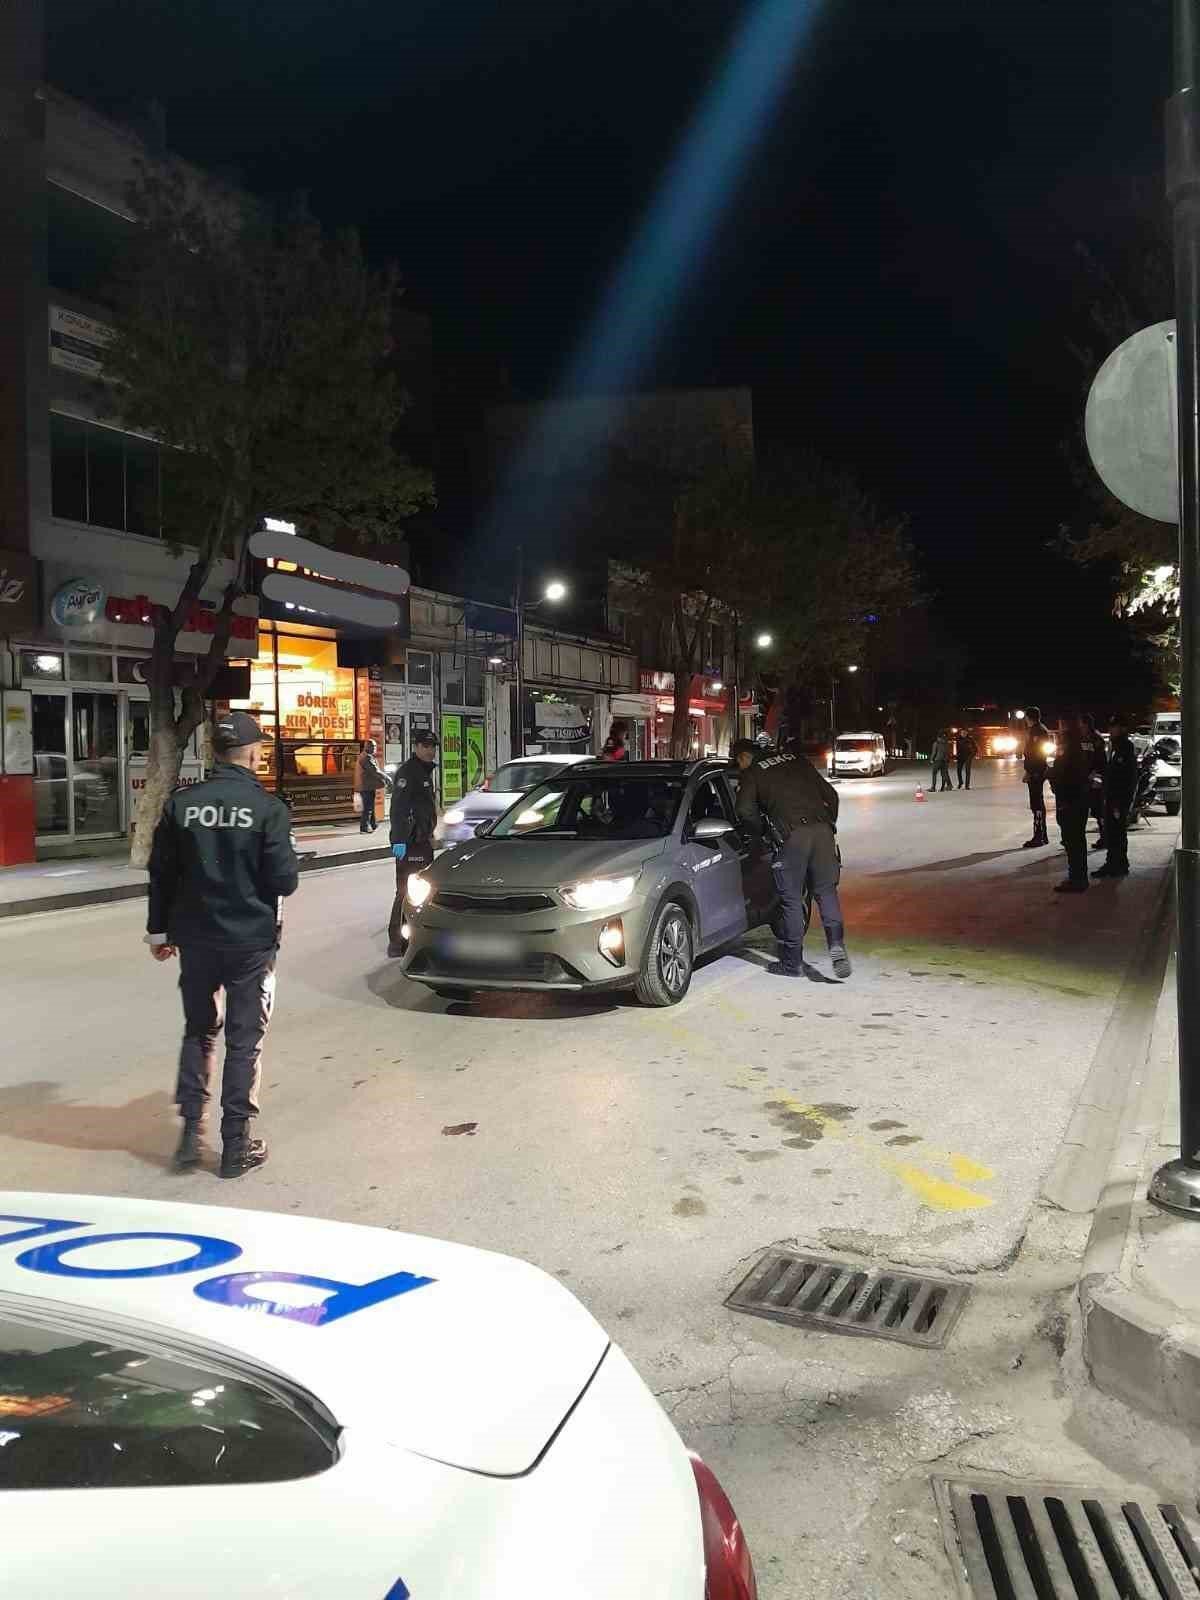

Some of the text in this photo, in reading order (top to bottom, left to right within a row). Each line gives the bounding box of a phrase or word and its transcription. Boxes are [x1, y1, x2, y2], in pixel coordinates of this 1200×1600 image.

[67, 590, 101, 609] Ayran
[297, 691, 337, 708] BÖREK
[286, 713, 349, 729] KIR PİDESİ
